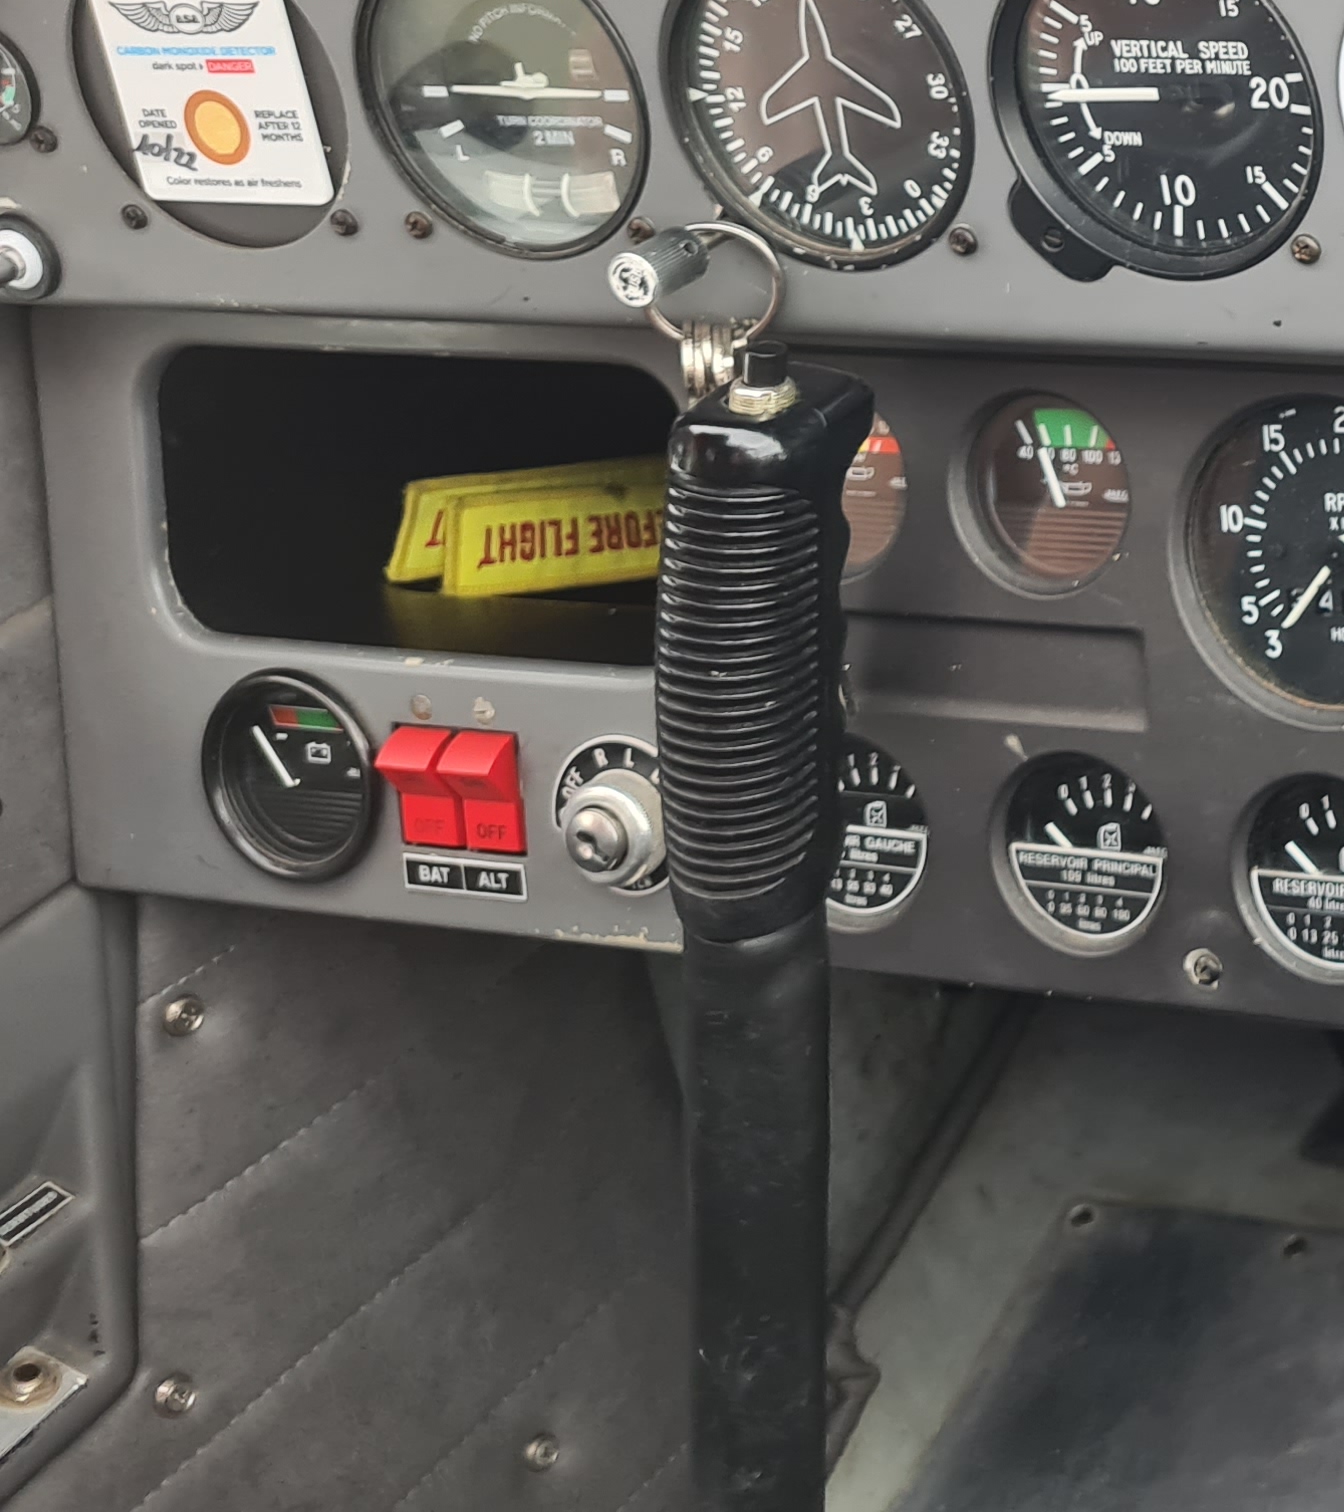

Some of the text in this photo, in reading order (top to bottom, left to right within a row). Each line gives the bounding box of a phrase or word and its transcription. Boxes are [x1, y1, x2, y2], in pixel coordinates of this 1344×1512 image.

[1111, 39, 1249, 59] VERTICAL SPEED
[1114, 58, 1251, 76] 100 FEET PER MINUTE
[142, 109, 167, 119] DATE
[254, 110, 299, 120] REPLACE
[138, 120, 178, 130] OPENED
[477, 824, 507, 840] OFF
[418, 866, 450, 885] BAT
[477, 871, 508, 890] ALT
